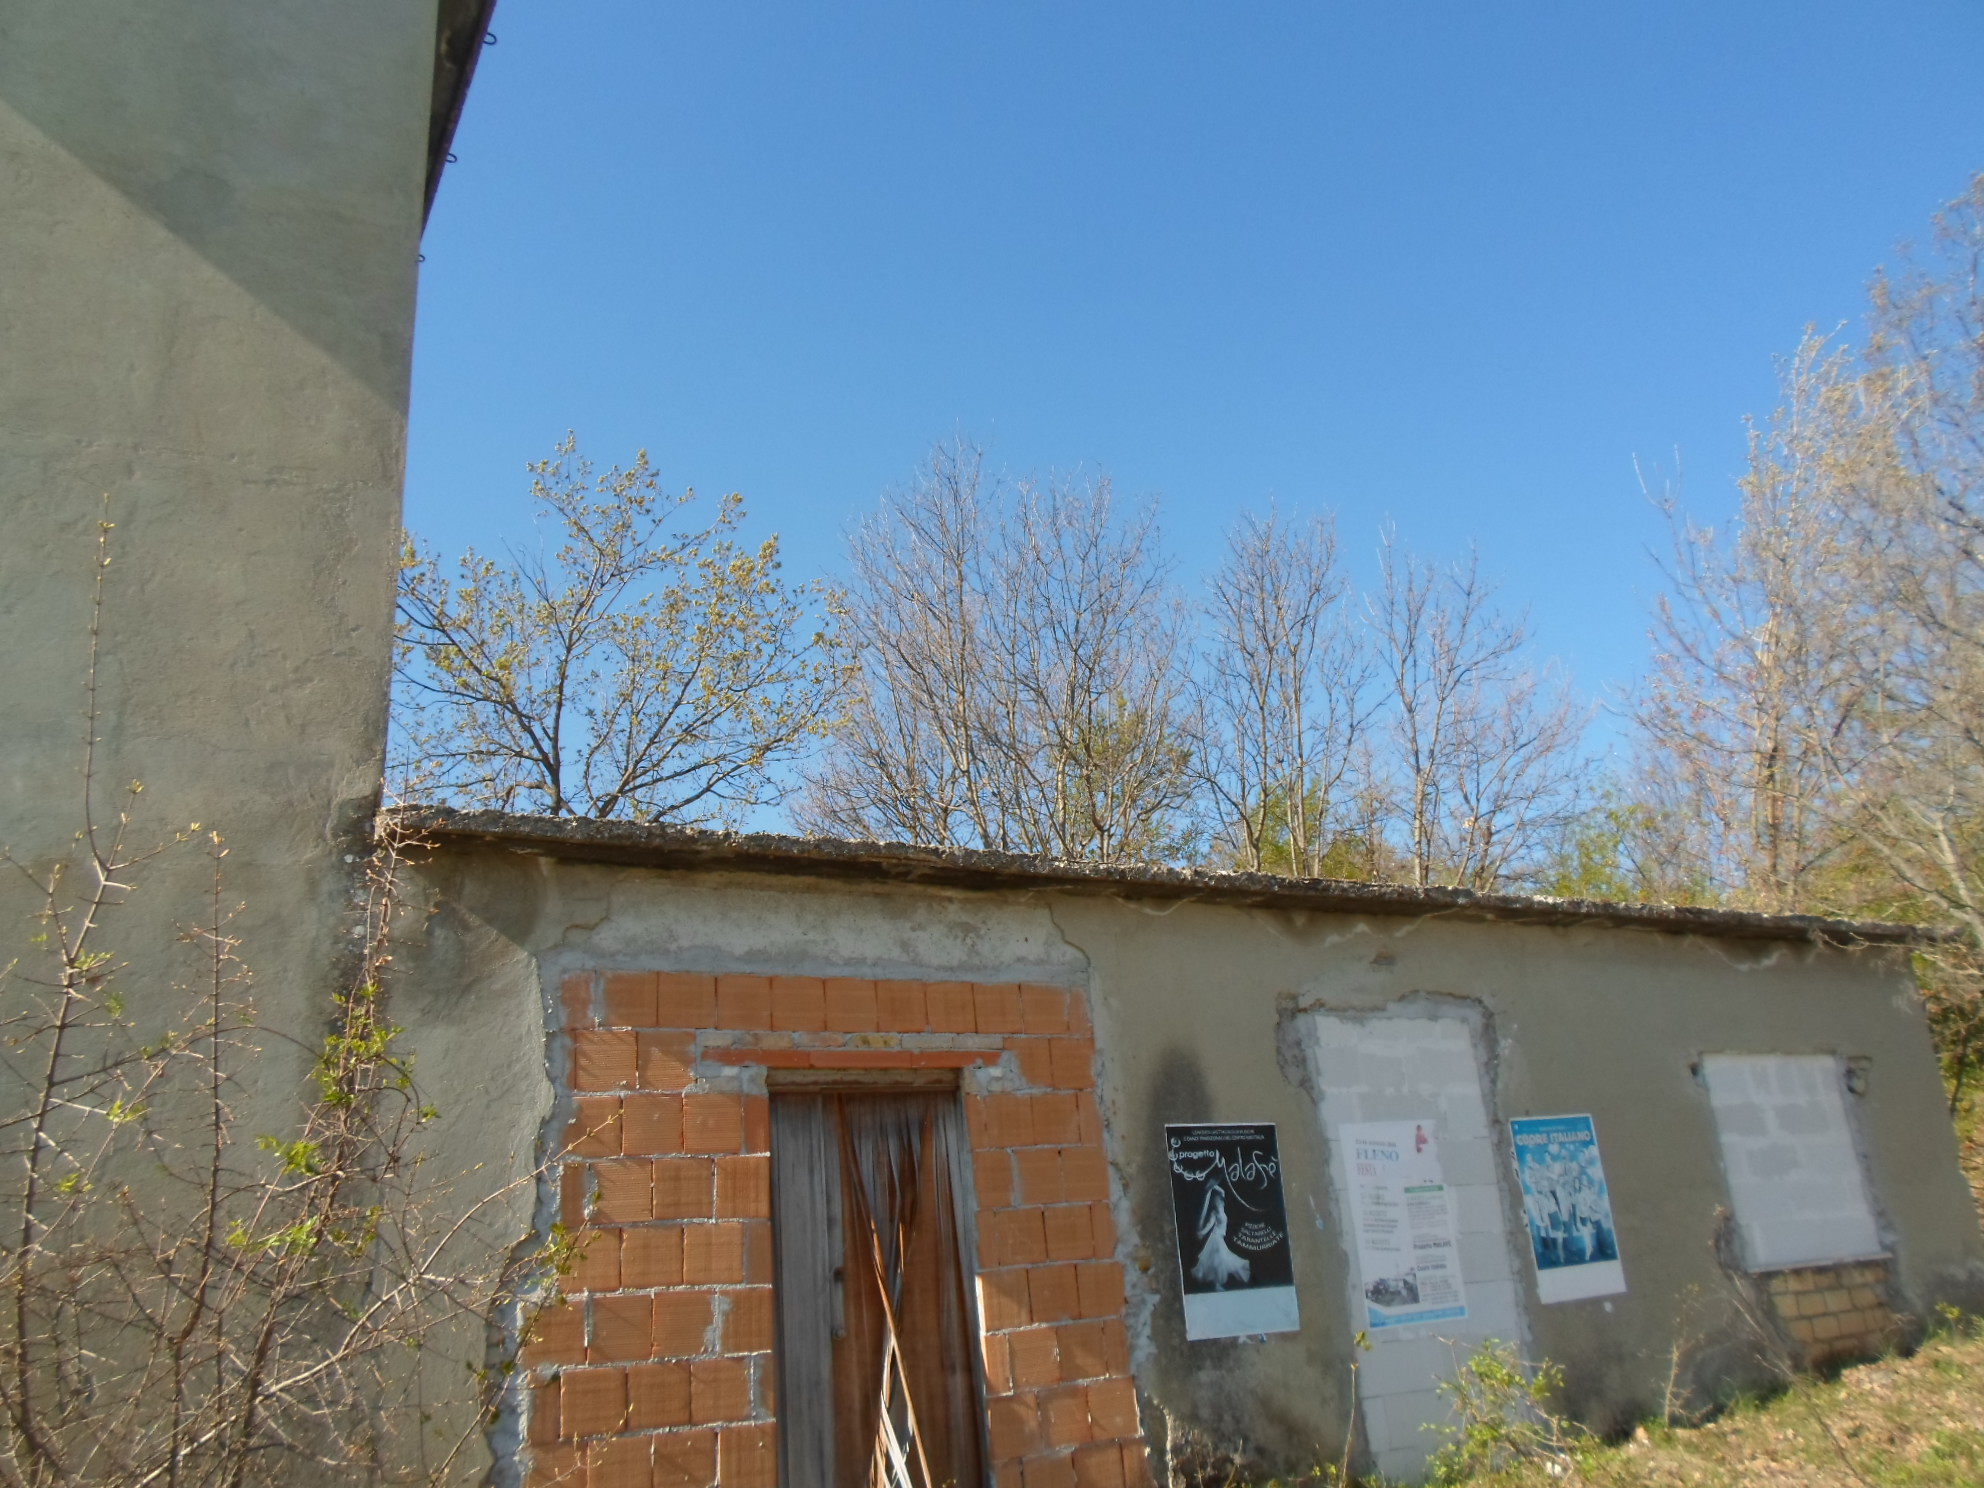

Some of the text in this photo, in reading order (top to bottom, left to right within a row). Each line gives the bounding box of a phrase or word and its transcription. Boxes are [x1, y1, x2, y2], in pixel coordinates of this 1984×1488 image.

[1516, 1130, 1591, 1145] CUORE ITALIANO
[1179, 1149, 1215, 1160] progetto
